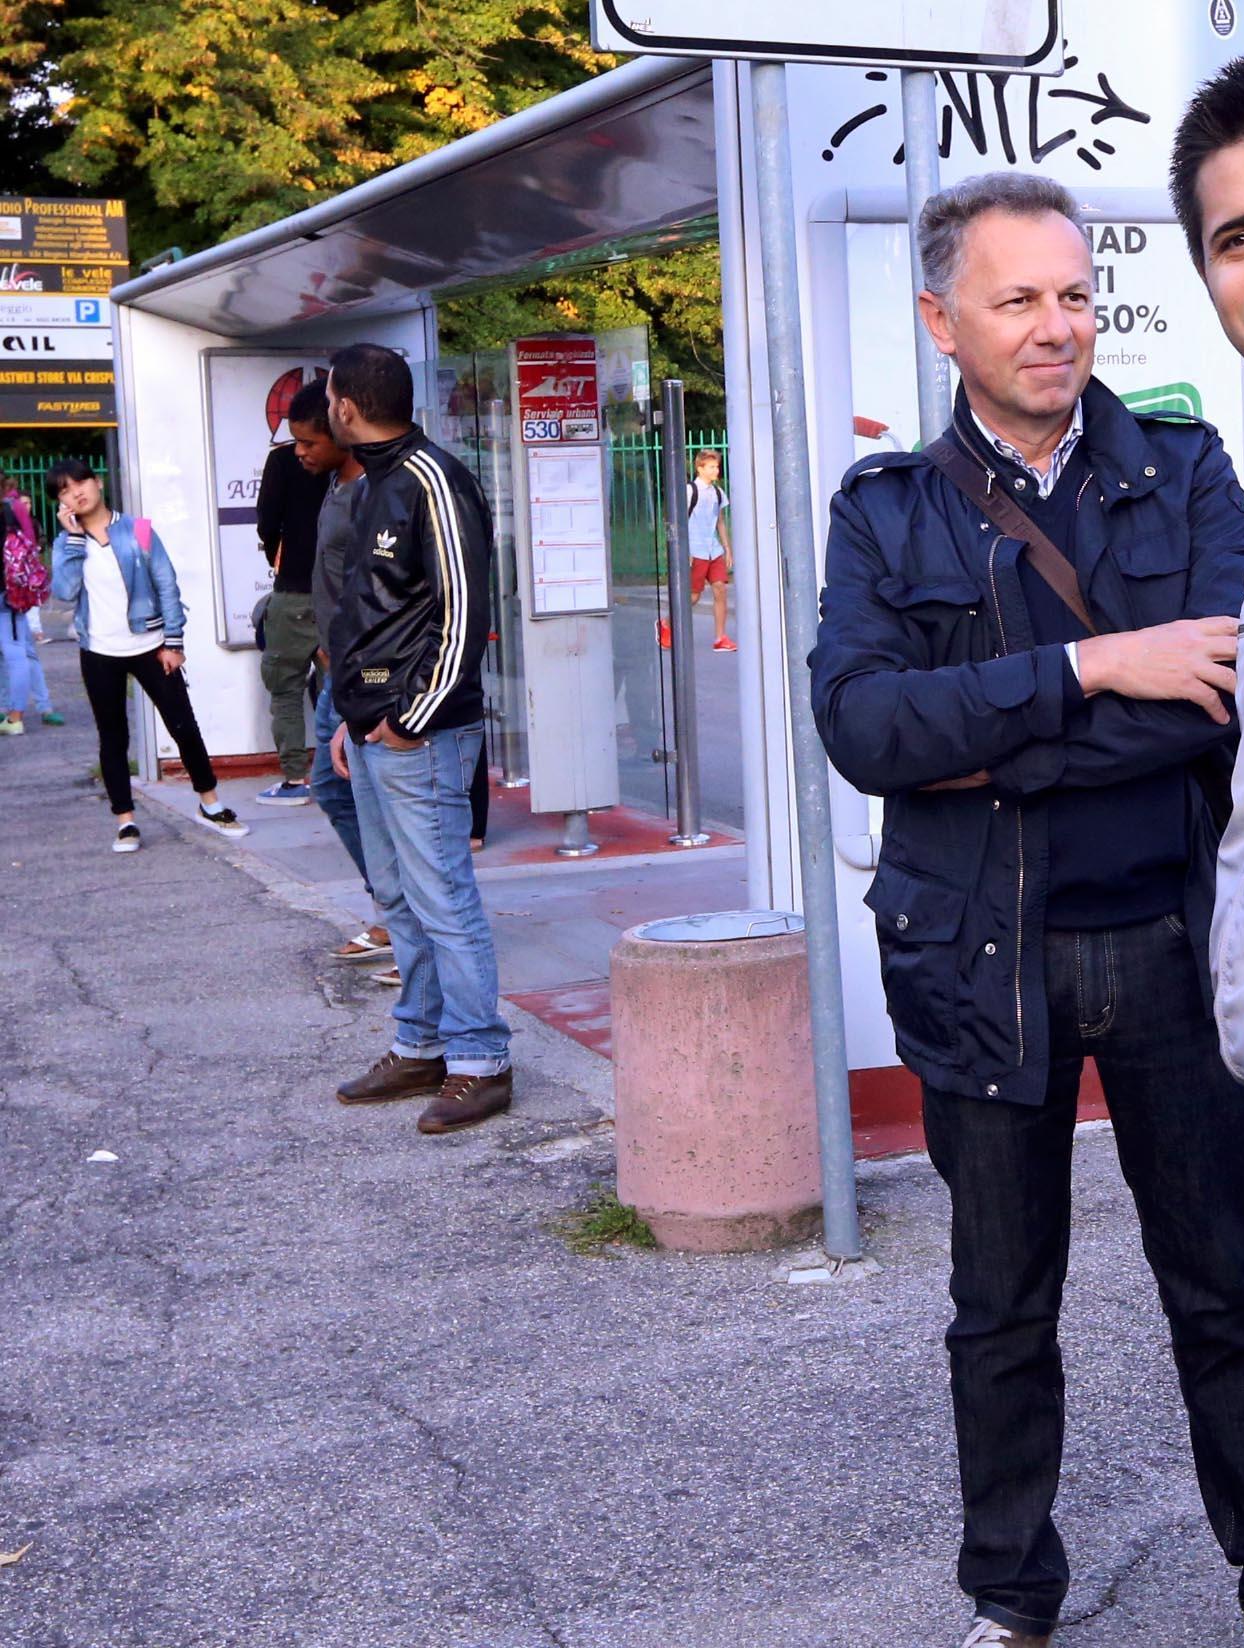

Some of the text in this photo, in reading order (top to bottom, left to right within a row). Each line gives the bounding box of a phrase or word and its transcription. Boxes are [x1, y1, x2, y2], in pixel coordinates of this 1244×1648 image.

[79, 302, 96, 320] P
[1094, 304, 1168, 334] 50%
[524, 420, 560, 439] 530
